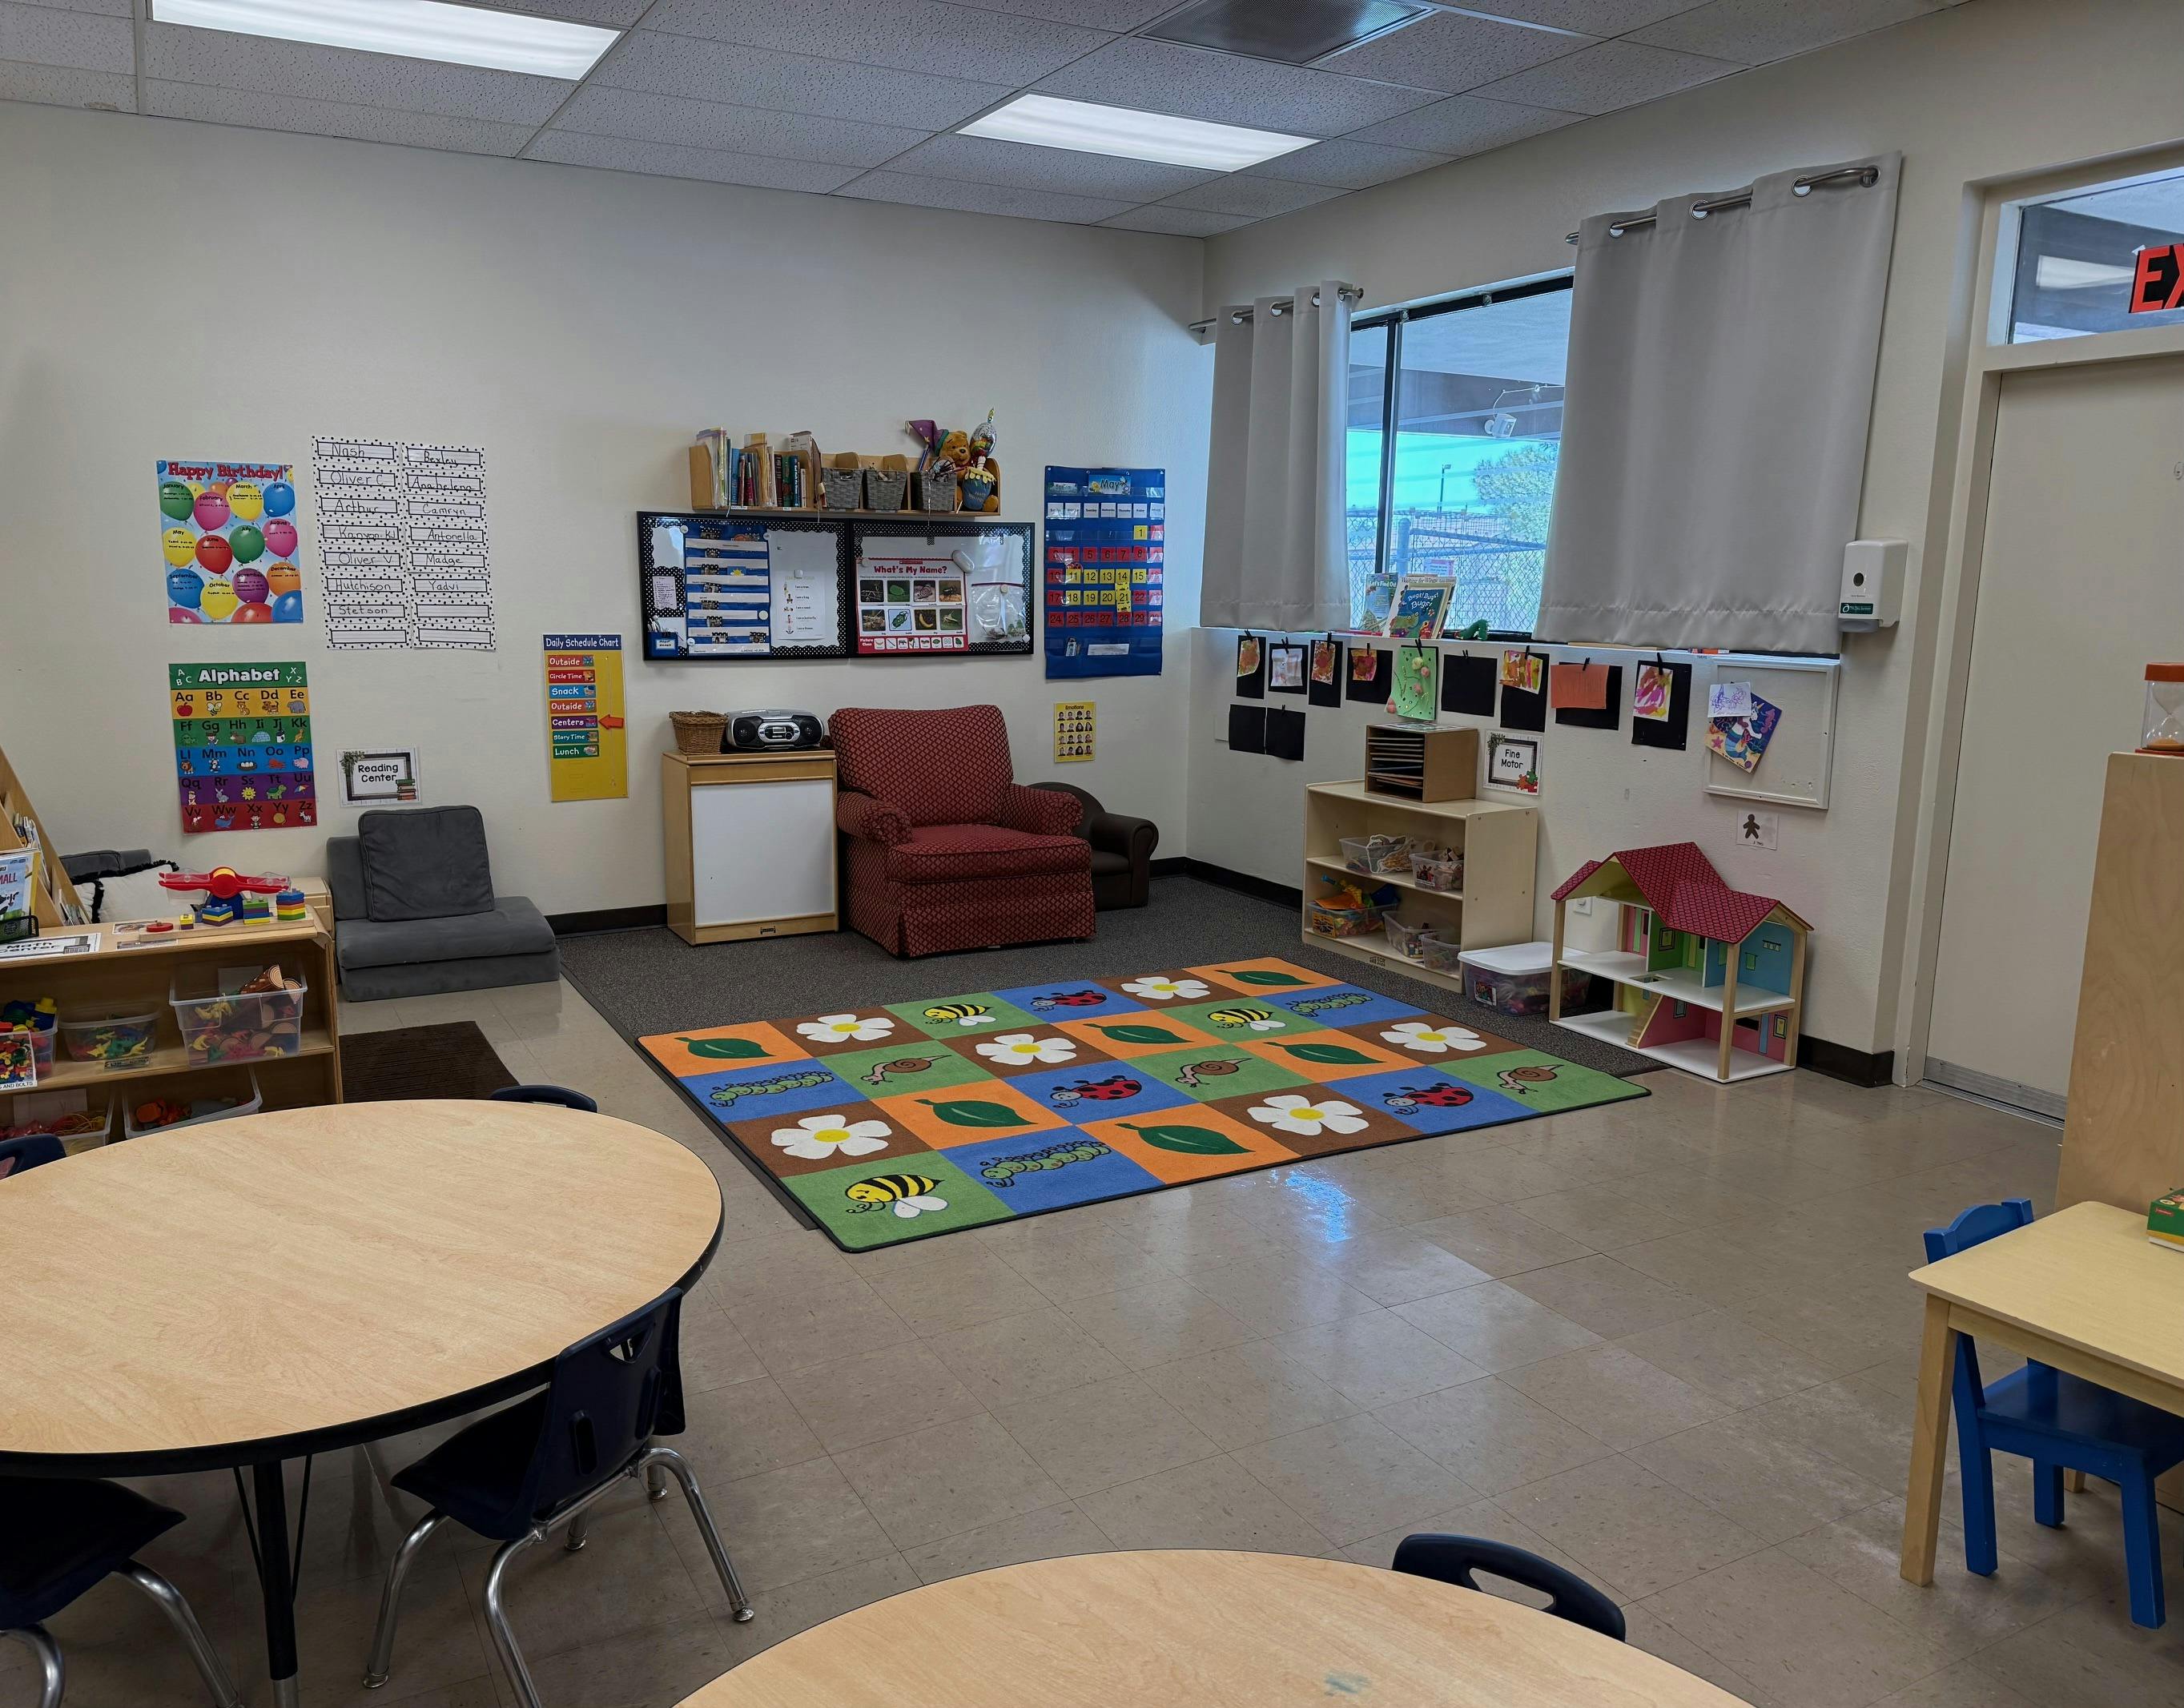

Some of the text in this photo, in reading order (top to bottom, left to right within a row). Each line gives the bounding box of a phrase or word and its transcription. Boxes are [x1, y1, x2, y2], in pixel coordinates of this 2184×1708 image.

[332, 444, 364, 457] Nash
[424, 450, 458, 468] Bexley
[167, 462, 284, 481] Happy Birthday!
[331, 471, 384, 485] Oliver C
[1100, 479, 1120, 492] May
[335, 500, 379, 512] Arthur
[422, 504, 466, 516] Camryn
[427, 528, 477, 541] Antonella
[1139, 528, 1143, 537] 1
[338, 552, 392, 565] Oliver V
[426, 553, 464, 565] Madge
[1088, 549, 1143, 559] 5 6 7 8
[874, 565, 947, 576] What's My Name?
[1069, 572, 1077, 581] 11
[1086, 572, 1096, 581] 12
[1103, 572, 1112, 581] 13
[1118, 572, 1128, 581] 14
[1135, 571, 1144, 580] 15
[336, 578, 392, 591] Hutchison
[428, 580, 459, 591] Yadvi
[1050, 593, 1060, 601] 17
[1068, 593, 1078, 602] 18
[1087, 593, 1096, 602] 19
[1102, 593, 1112, 602] 20
[1119, 593, 1128, 602] 21
[1135, 593, 1144, 601] 22
[339, 605, 388, 615] Stetson
[1050, 614, 1061, 624] 24
[1100, 614, 1111, 624] 27
[1135, 613, 1144, 622] 29
[545, 637, 619, 649] Daily Schedule Chart
[549, 657, 581, 665] Outside
[178, 669, 186, 677] A
[199, 668, 280, 685] Alphabet
[176, 676, 192, 686] B C
[296, 676, 302, 684] Z
[175, 689, 304, 702] Aa Bb Cc Dd Ee
[551, 687, 579, 696] Snack
[551, 702, 582, 710] Outside
[180, 717, 308, 733] Ff Gg Hh Ii Jj Kk
[552, 718, 584, 726] Centers
[180, 745, 310, 759] Ll Mm Nn Oo Pp
[555, 747, 580, 756] Lunch
[1505, 749, 1521, 758] Fine
[358, 763, 399, 774] Reading
[1501, 758, 1524, 770] Motor
[181, 773, 312, 790] Qq Rr Ss Tt Uu
[361, 774, 397, 782] Center
[185, 801, 313, 817] Vv Ww Xx Yy Zz
